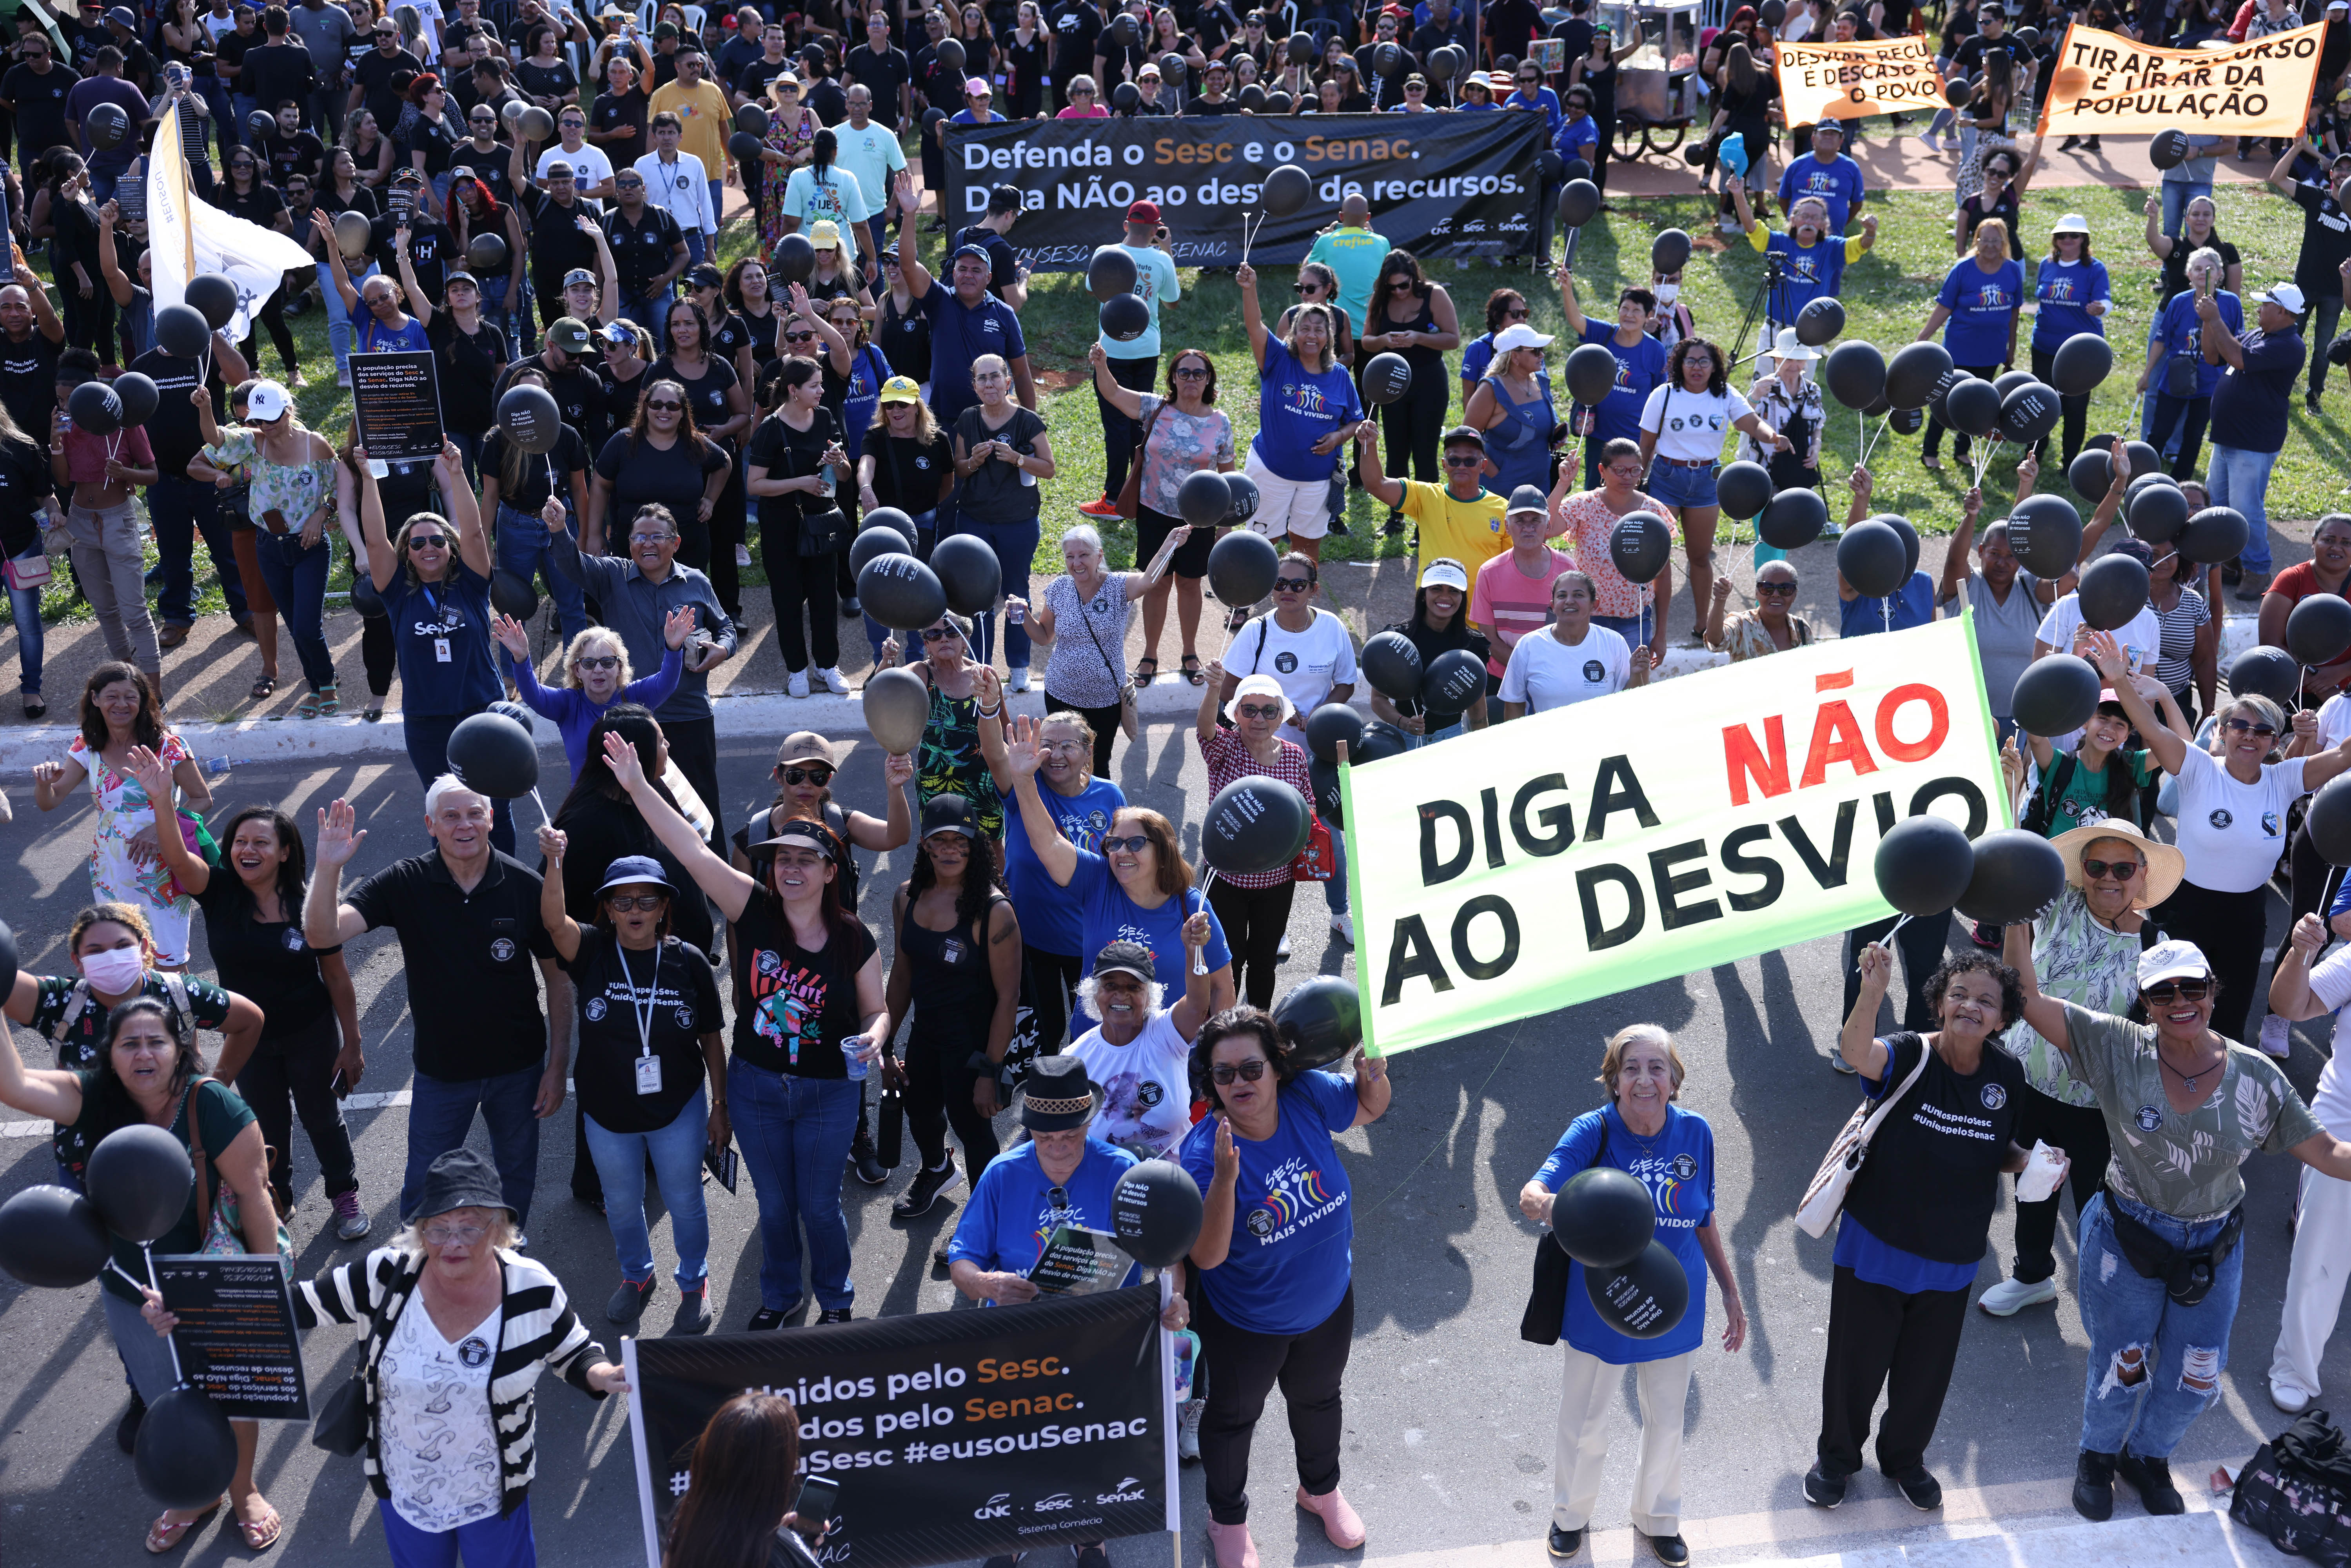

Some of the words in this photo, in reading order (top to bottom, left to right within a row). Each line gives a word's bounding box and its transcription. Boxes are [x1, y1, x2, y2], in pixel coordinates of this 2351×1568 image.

[2073, 42, 2164, 73] TIRAR
[1825, 65, 1916, 84] DESCASO
[2224, 66, 2264, 86] DA
[1851, 88, 1865, 103] O
[1877, 81, 1936, 100] POVO
[2074, 88, 2268, 119] POPULAÇÃO
[965, 139, 1112, 170] Defenda
[1124, 145, 1144, 165] o
[1155, 138, 1233, 165] Sesc
[1244, 142, 1264, 162] e
[1274, 141, 1294, 162] o
[1305, 135, 1420, 162] Senac.
[1058, 176, 1135, 209] NÃO
[1146, 186, 1186, 207] ao
[1319, 175, 1362, 203] de
[1374, 173, 1525, 201] recursos.
[1463, 222, 1485, 232] Sesc
[1499, 222, 1529, 232] Senac
[2317, 212, 2347, 232] PUMA
[1333, 236, 1374, 249] crefisa
[1301, 383, 1322, 394] SESC
[850, 394, 875, 403] VIVIDOS
[1284, 404, 1302, 414] MAIS
[1304, 410, 1333, 420] VIVIDOS
[1416, 754, 1662, 887] DIGA
[1721, 667, 1950, 807] NÃO
[1244, 788, 1254, 800] Diga
[1253, 799, 1265, 812] NÃO
[1244, 799, 1258, 816] desvio
[1060, 815, 1091, 828] SESC
[1236, 802, 1255, 823] recursos
[1380, 894, 1521, 1008] AO
[1575, 776, 1989, 952] DESVIO
[1117, 924, 1153, 944] SESC
[2151, 947, 2168, 961] SESC
[790, 981, 823, 1004] LOVE
[1265, 1157, 1307, 1191] SESC
[1629, 1158, 1675, 1175] SESC
[1124, 1197, 1147, 1206] recursos
[1127, 1189, 1146, 1198] desvio
[1260, 1225, 1295, 1246] MAIS
[1298, 1191, 1347, 1227] VIVIDOS
[1060, 1245, 1094, 1256] população
[1095, 1251, 1117, 1260] precisa
[1062, 1254, 1088, 1264] serviços
[1040, 1268, 1061, 1277] desvio
[1071, 1275, 1098, 1283] recursos.
[1054, 1261, 1075, 1270] Senac.
[1093, 1267, 1107, 1276] NÃO
[1624, 1303, 1647, 1322] recursos
[1632, 1311, 1649, 1325] desvio
[1649, 1309, 1662, 1321] Diga
[1637, 1320, 1650, 1330] NÃO
[745, 1375, 876, 1406] nidos
[887, 1363, 966, 1401] pelo
[977, 1356, 1069, 1383] Sesc.
[875, 1403, 954, 1439] pelo
[965, 1392, 1084, 1422] Senac.
[904, 1417, 1147, 1463] #eusouSenac
[974, 1501, 1010, 1519] CNC
[1034, 1496, 1073, 1512] Sesc
[1096, 1485, 1145, 1505] Senac
[1018, 1523, 1057, 1535] Sistema
[1059, 1516, 1103, 1529] Comércio
